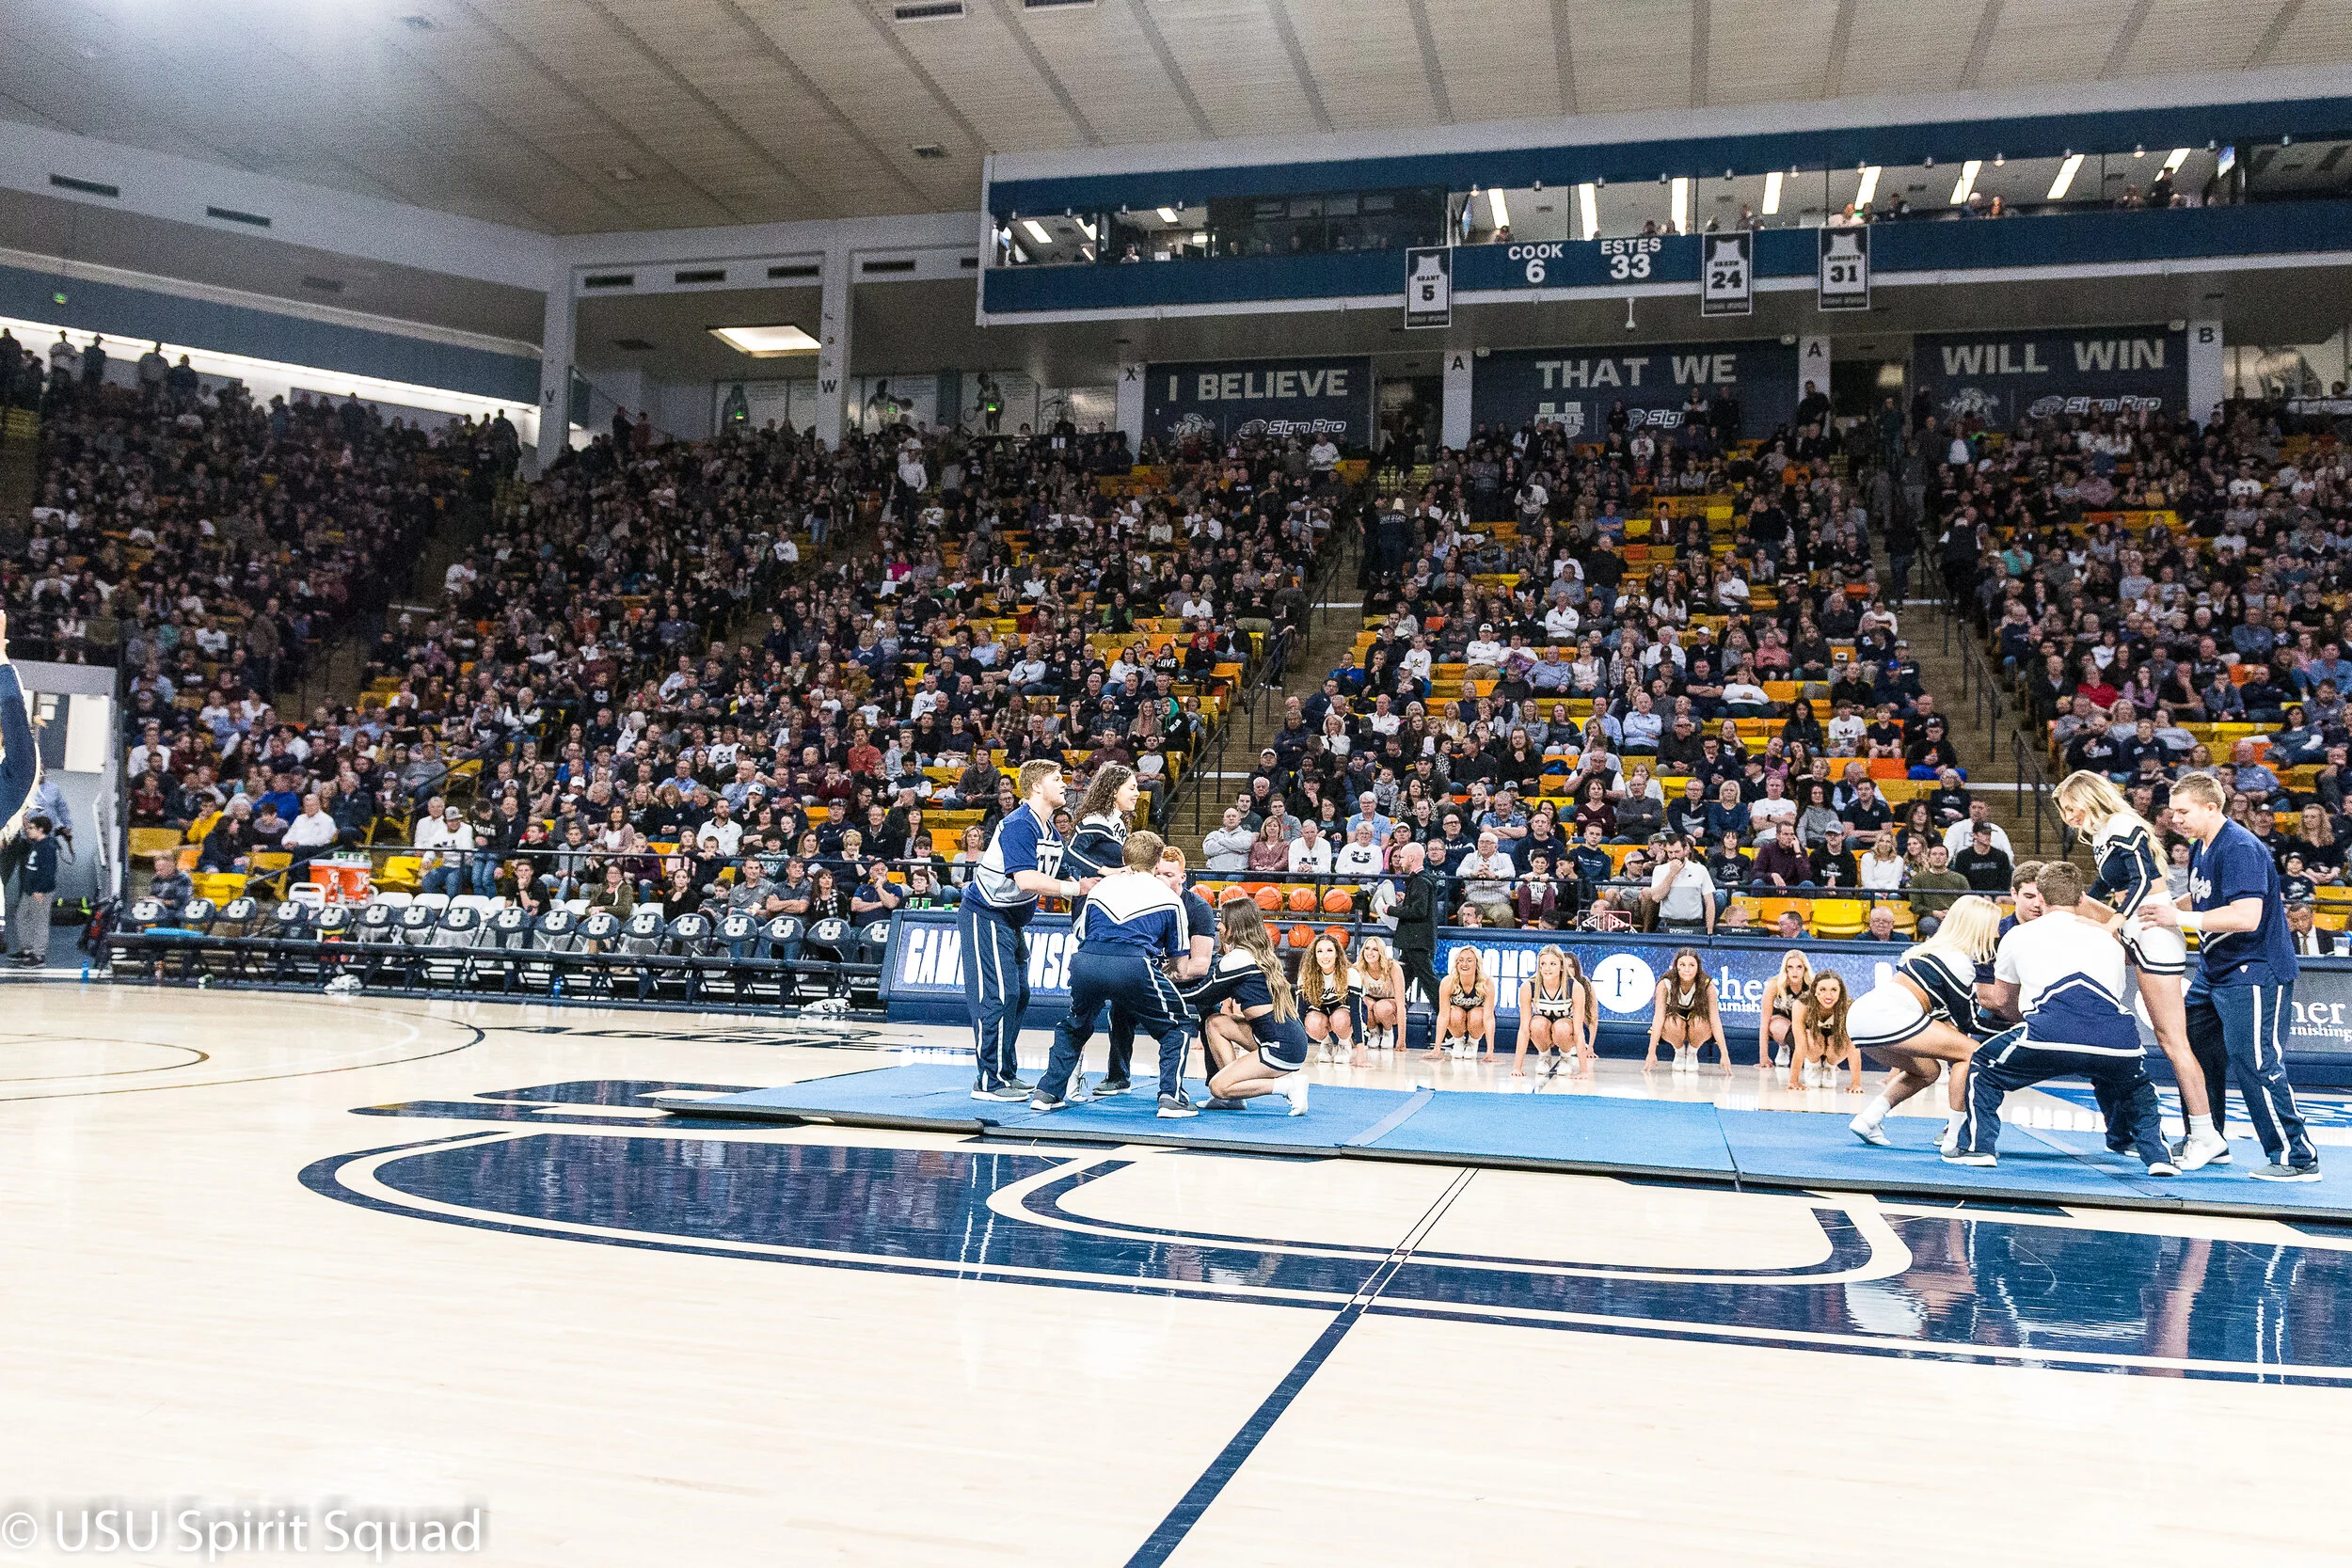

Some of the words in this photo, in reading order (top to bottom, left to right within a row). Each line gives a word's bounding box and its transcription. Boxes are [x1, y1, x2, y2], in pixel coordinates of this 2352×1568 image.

[1508, 244, 1564, 260] COOK
[1600, 237, 1662, 255] ESTES
[1525, 259, 1546, 283] 6
[1610, 254, 1651, 279] 33
[1830, 265, 1857, 282] 31
[1711, 270, 1742, 289] 24
[1422, 285, 1435, 301] 5
[2199, 327, 2214, 343] B
[1808, 341, 1822, 357] A
[1941, 343, 2049, 375] WILL
[2074, 339, 2165, 372] WIN
[1451, 355, 1465, 372] A
[1535, 356, 1649, 389] THAT
[1672, 354, 1738, 385] WE
[1125, 367, 1136, 381] X
[821, 379, 837, 393] W
[1168, 375, 1178, 402] I
[1198, 370, 1348, 401] BELIEVE
[545, 388, 555, 404] V
[1267, 420, 1310, 437] Sign
[1312, 419, 1346, 434] Pro
[903, 928, 965, 984] GAM
[1615, 967, 1634, 997] F
